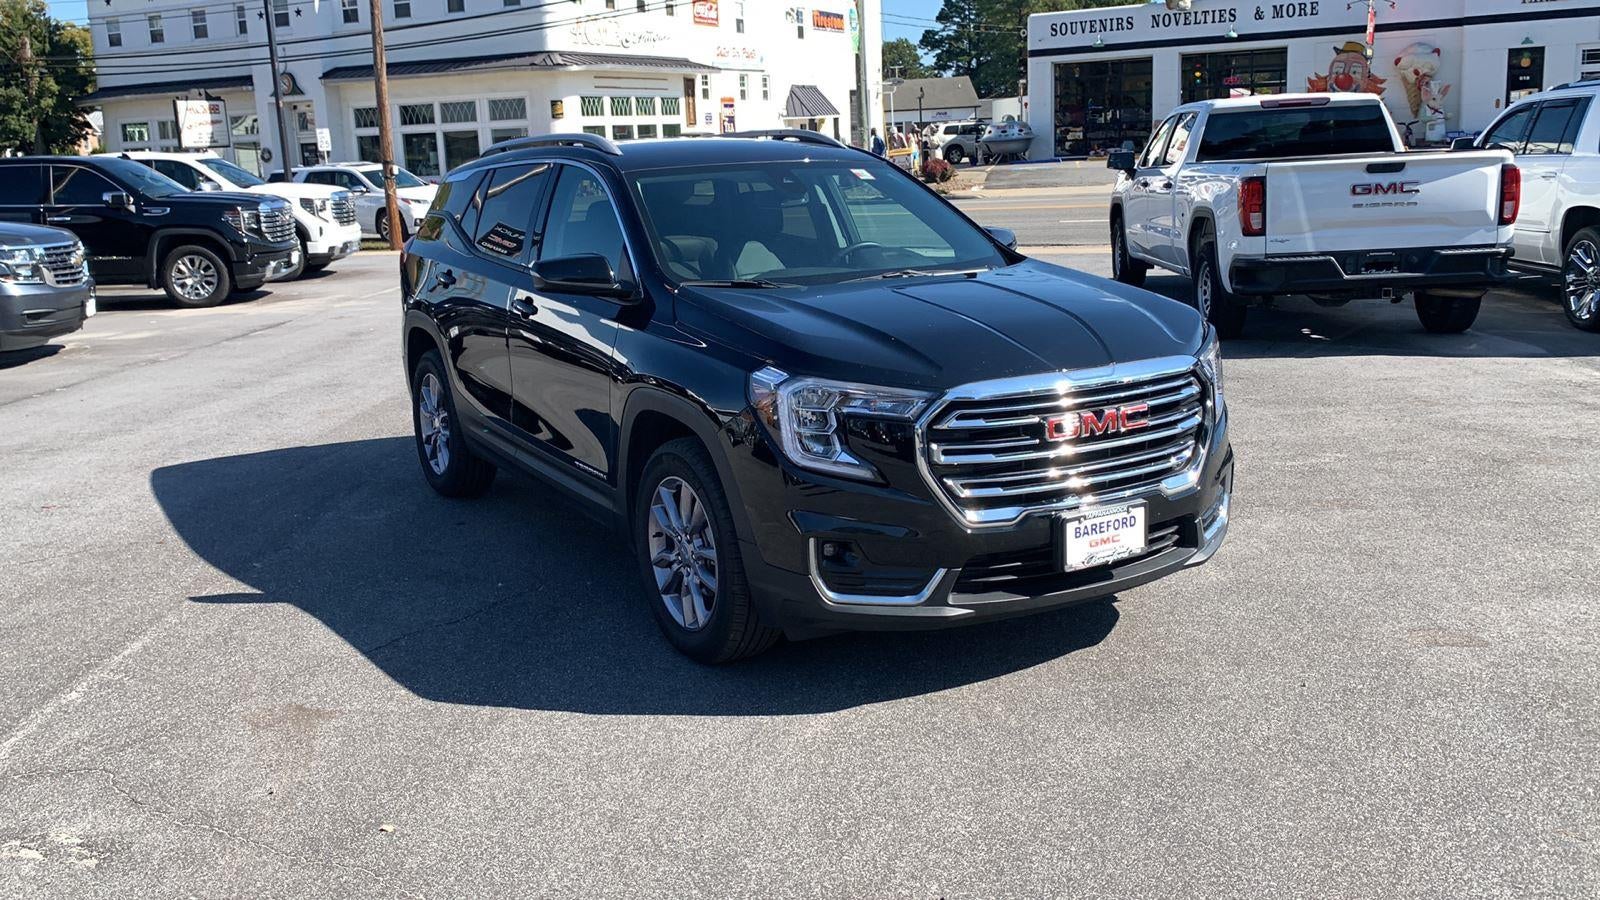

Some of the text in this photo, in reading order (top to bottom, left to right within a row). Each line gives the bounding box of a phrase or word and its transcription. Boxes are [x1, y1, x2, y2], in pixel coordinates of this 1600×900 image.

[1050, 1, 1319, 37] SOUVENIRS NOVELTIES & MORE
[1351, 181, 1420, 195] GMC
[1046, 404, 1148, 440] GMC
[1074, 515, 1137, 539] BAREFORD
[1088, 534, 1121, 548] GMC
